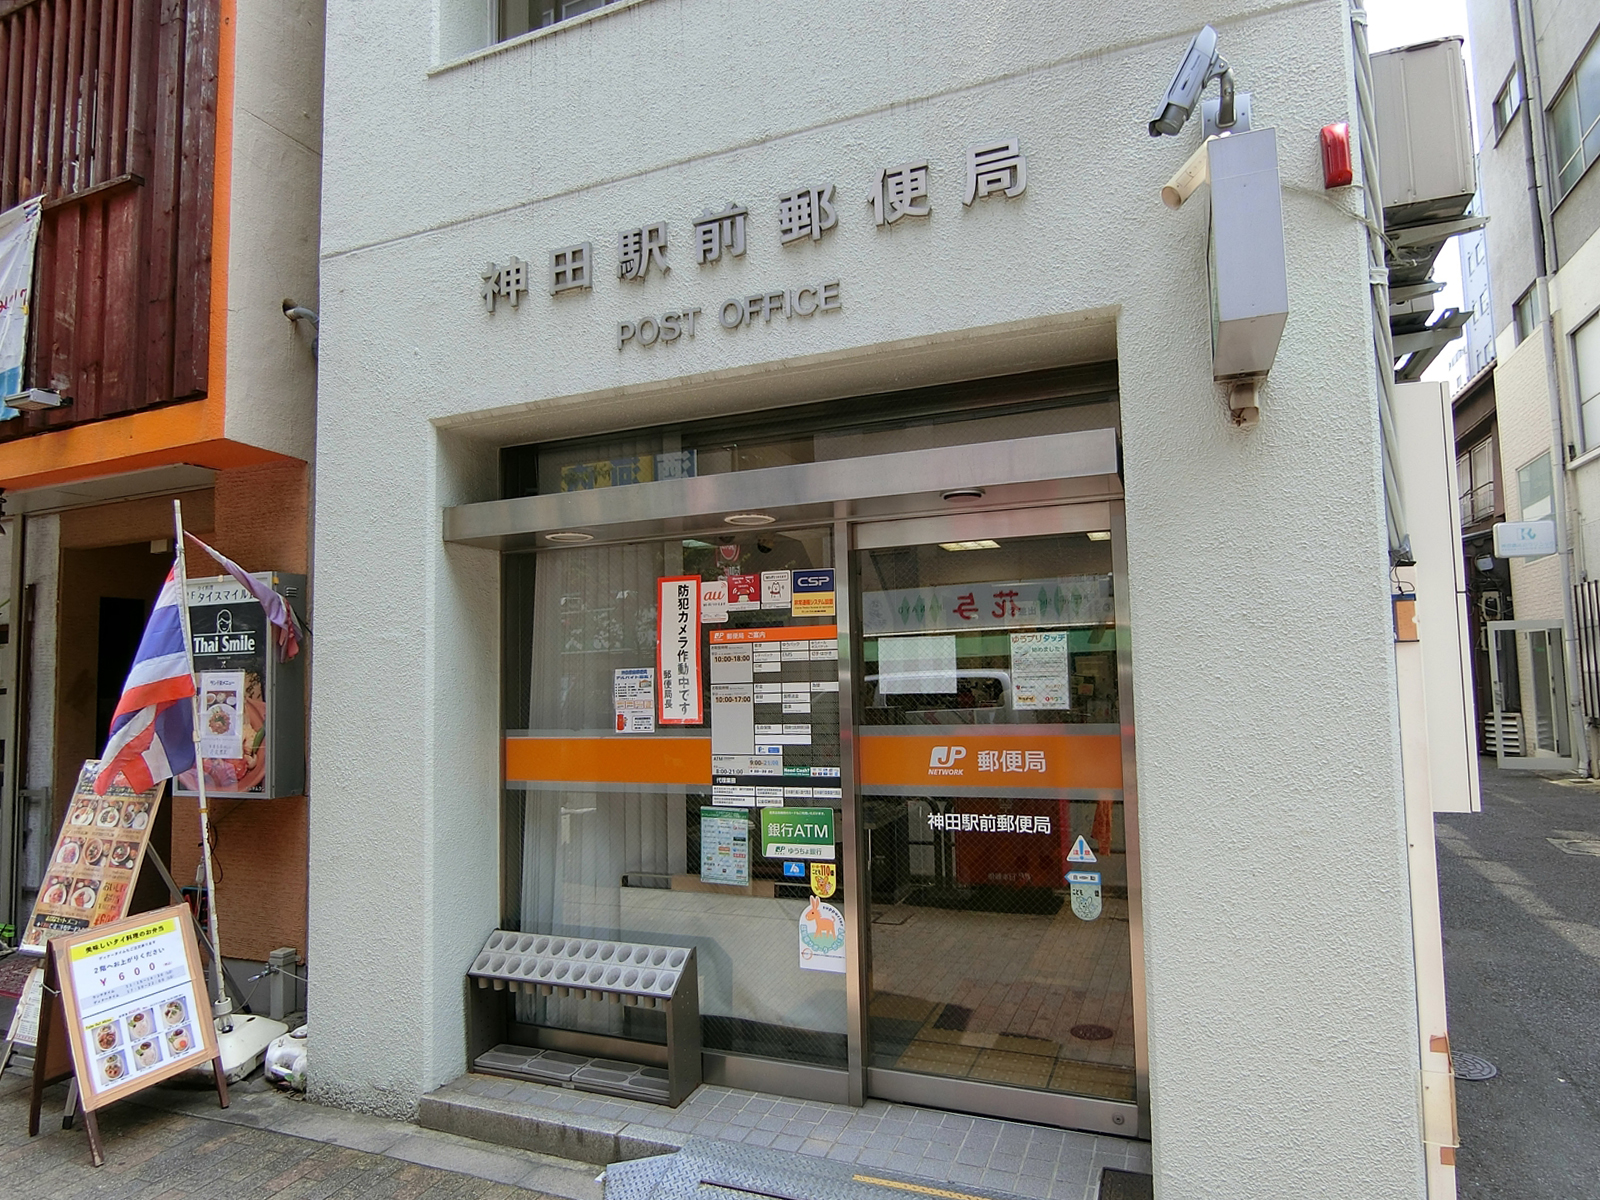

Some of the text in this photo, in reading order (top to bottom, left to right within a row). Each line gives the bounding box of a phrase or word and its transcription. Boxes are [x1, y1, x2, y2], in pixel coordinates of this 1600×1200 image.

[481, 137, 1028, 313] 神田駅前郵便局
[616, 279, 842, 351] POST OFFICE
[797, 576, 830, 587] CSP
[704, 590, 725, 601] au
[194, 634, 255, 653] Thai Smile
[677, 584, 690, 715] 防犯カメラ作動中です
[663, 670, 673, 709] 郵便局長
[978, 750, 1046, 773] 郵便局
[768, 822, 829, 838] 銀行ATM
[927, 812, 1051, 835] 神田駅前郵便局
[86, 925, 164, 953] 美味しいタイ料理のお弁当
